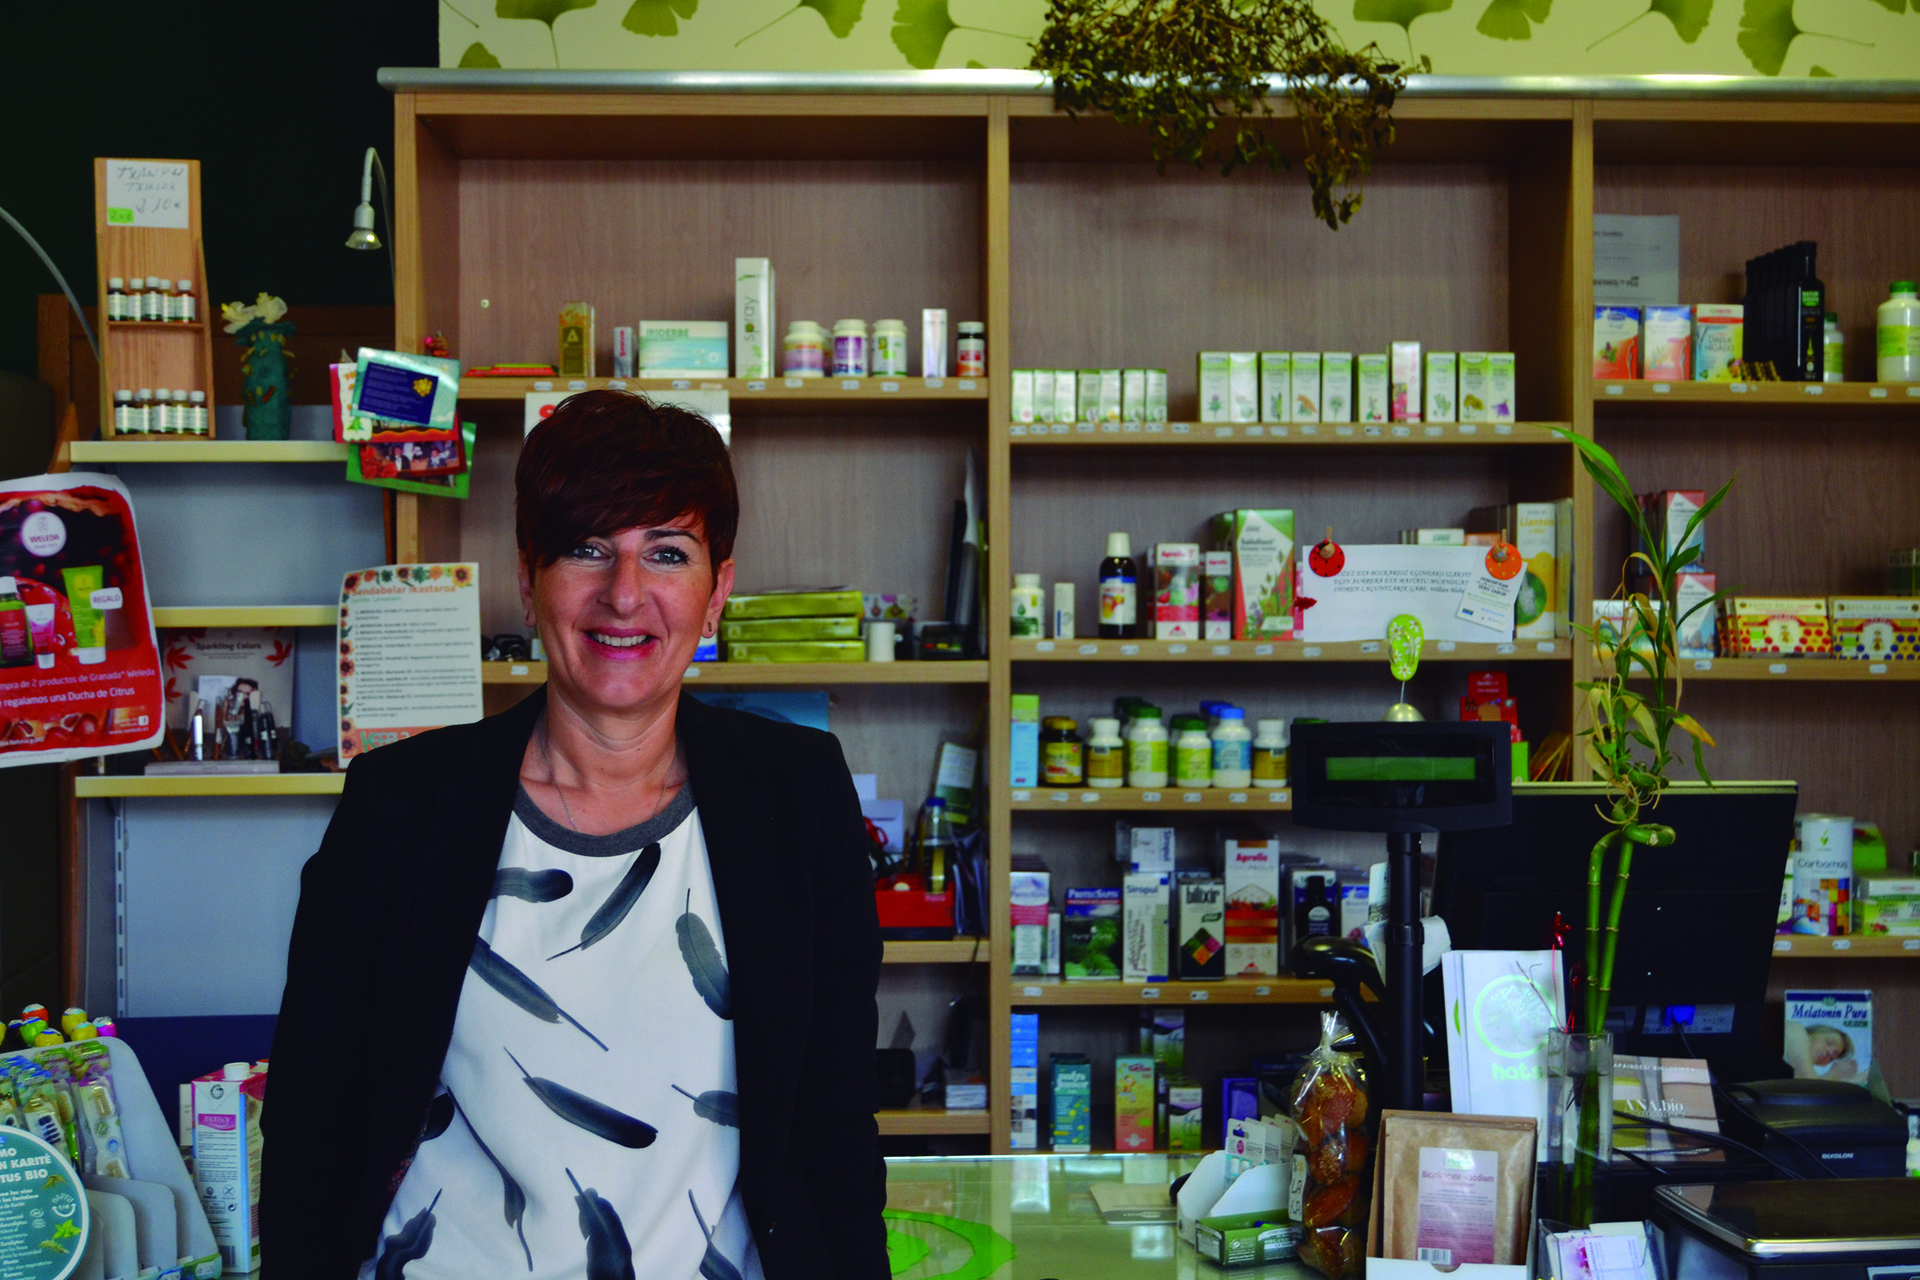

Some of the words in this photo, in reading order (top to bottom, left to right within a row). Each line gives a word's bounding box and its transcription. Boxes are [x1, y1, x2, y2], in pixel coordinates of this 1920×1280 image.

[744, 296, 760, 341] spray
[92, 595, 120, 604] REGALO
[196, 642, 235, 651] Sparkling
[20, 680, 30, 688] de
[32, 679, 37, 688] 2
[38, 676, 77, 688] productos
[79, 674, 88, 682] de
[126, 668, 155, 678] Weleda
[3, 696, 48, 708] regalamos
[50, 694, 67, 703] una
[68, 690, 95, 701] Ducha
[97, 690, 108, 698] de
[110, 687, 136, 697] Citrus
[1791, 1004, 1841, 1019] Melatonin
[1844, 1005, 1868, 1019] Pura
[10, 1152, 52, 1168] KARITÉ
[25, 1168, 48, 1180] BIO
